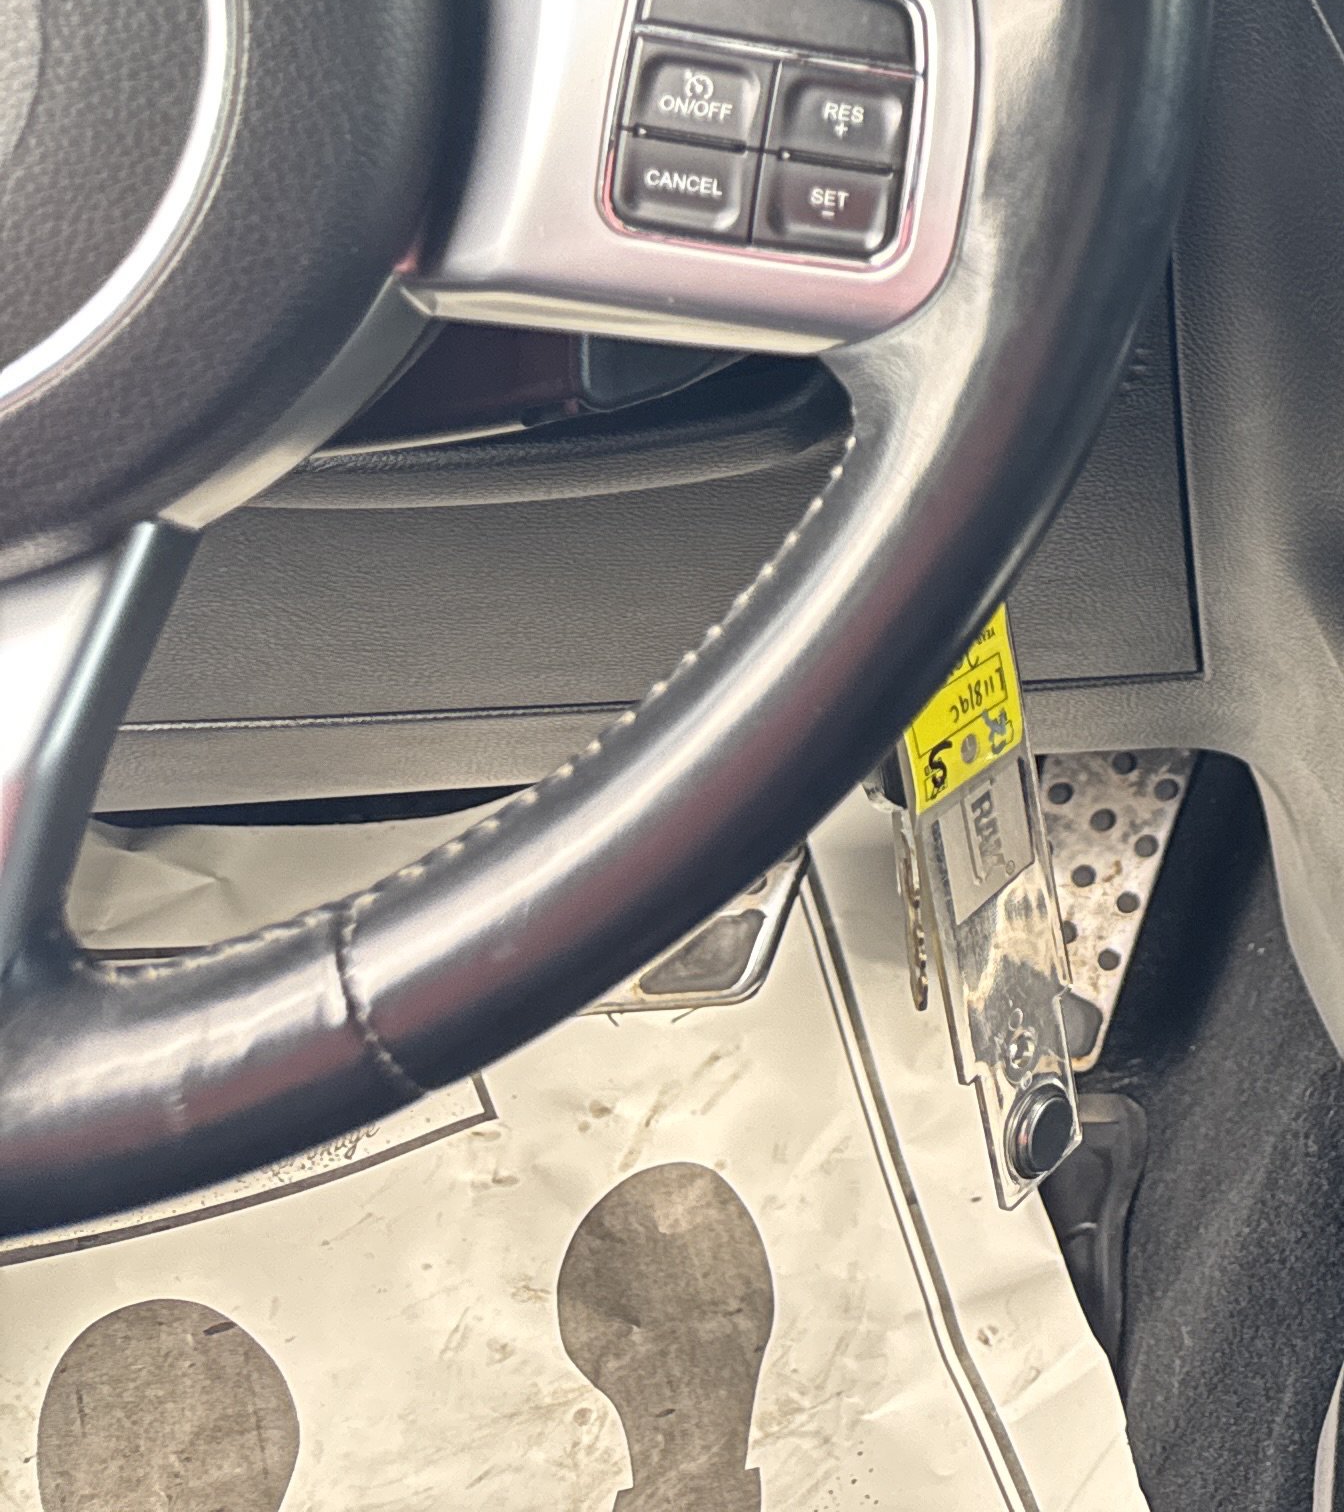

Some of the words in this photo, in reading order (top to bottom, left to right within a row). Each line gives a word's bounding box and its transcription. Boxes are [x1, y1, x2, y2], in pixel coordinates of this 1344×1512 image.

[659, 95, 733, 120] ON/OFF
[822, 102, 865, 124] RES
[645, 169, 723, 196] CANCEL
[810, 188, 850, 209] SET
